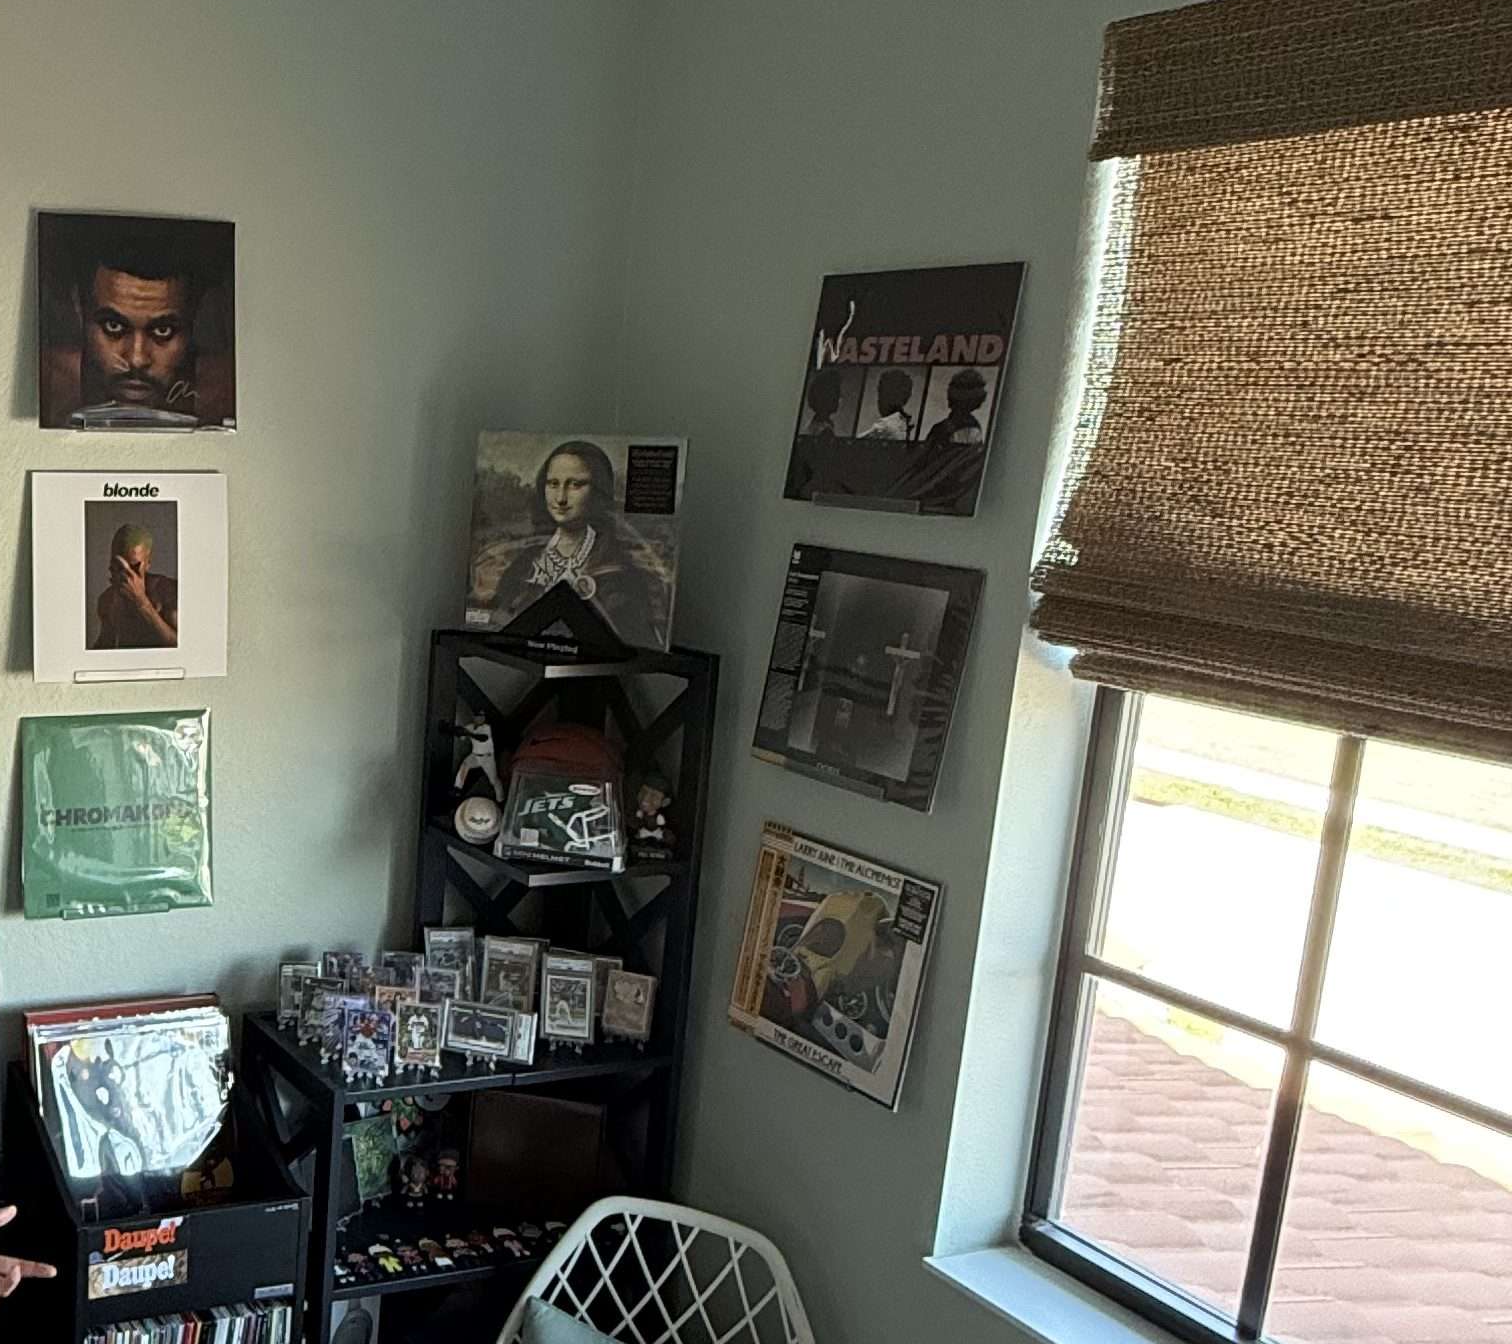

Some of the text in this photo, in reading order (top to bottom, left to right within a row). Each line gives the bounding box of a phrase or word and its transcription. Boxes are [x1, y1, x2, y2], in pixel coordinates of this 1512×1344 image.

[815, 298, 1005, 370] WASTELAND
[102, 482, 160, 498] blonde
[517, 796, 577, 817] JETS
[103, 1218, 178, 1255] Daupe!
[101, 1253, 176, 1290] Daupe!
